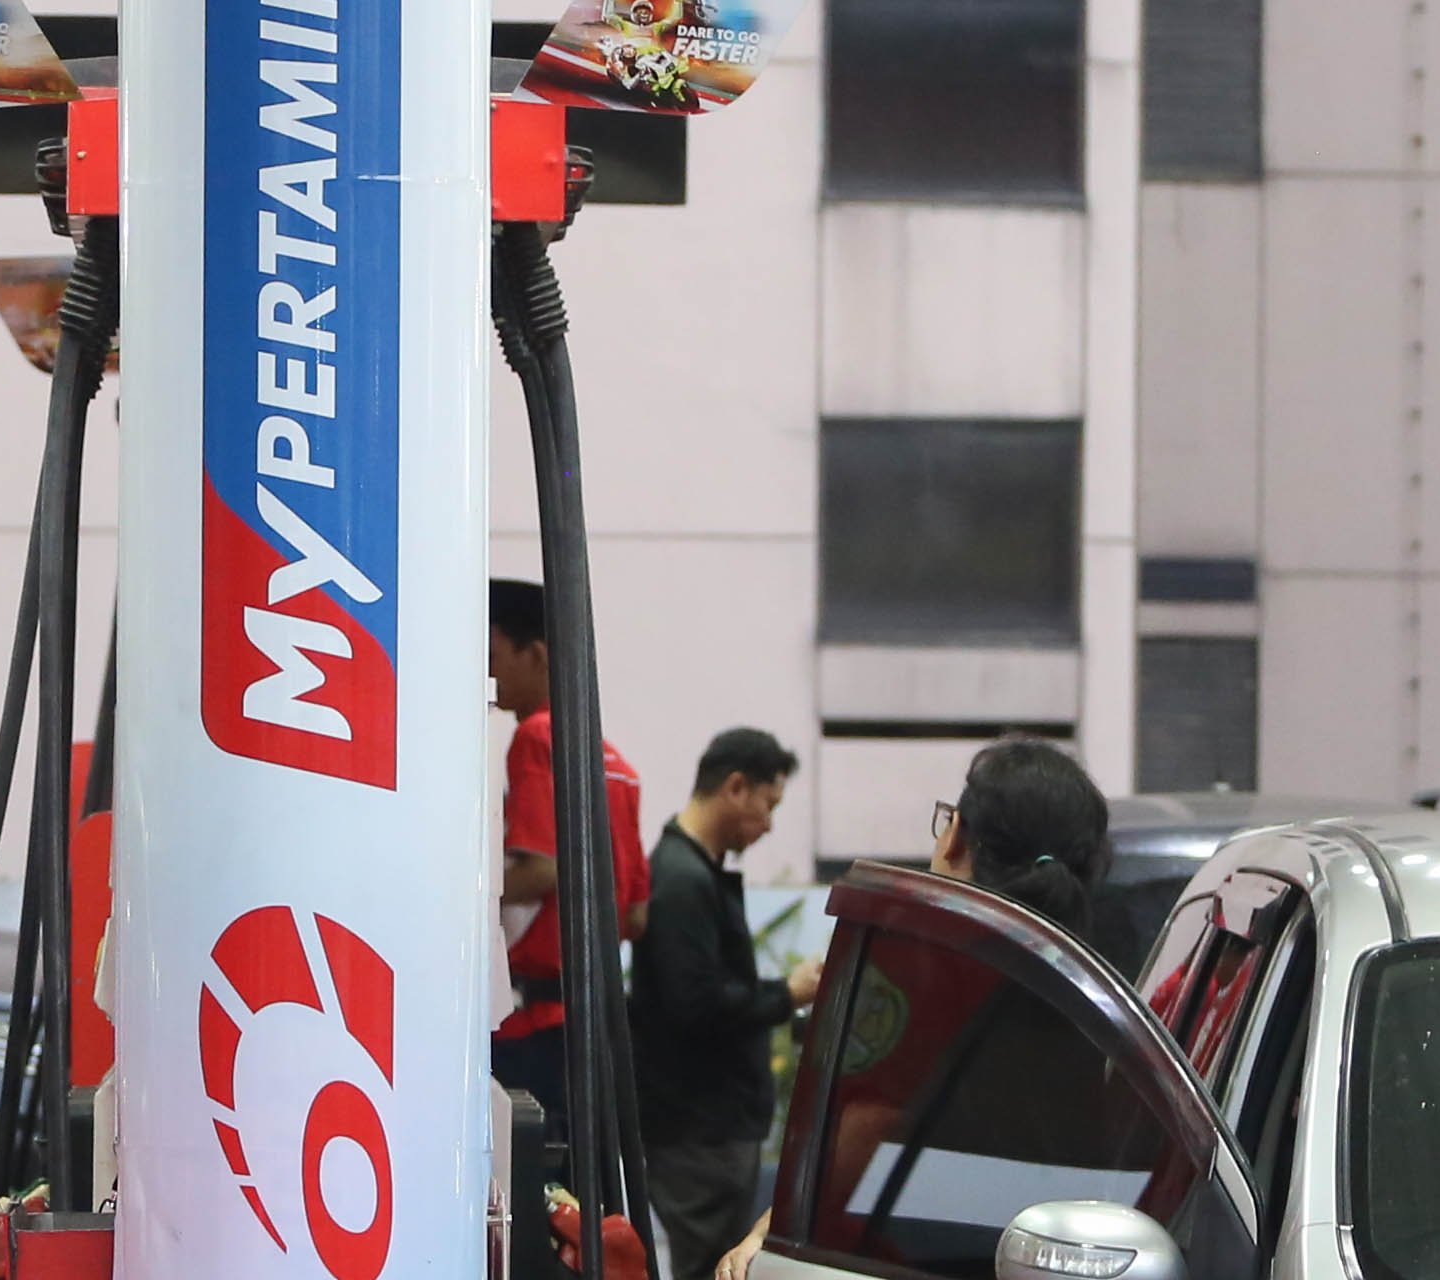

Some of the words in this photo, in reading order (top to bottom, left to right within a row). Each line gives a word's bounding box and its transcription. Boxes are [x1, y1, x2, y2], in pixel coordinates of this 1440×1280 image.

[677, 25, 714, 39] DARE
[716, 28, 734, 41] TO
[738, 31, 760, 44] GO
[672, 37, 759, 63] FASTER
